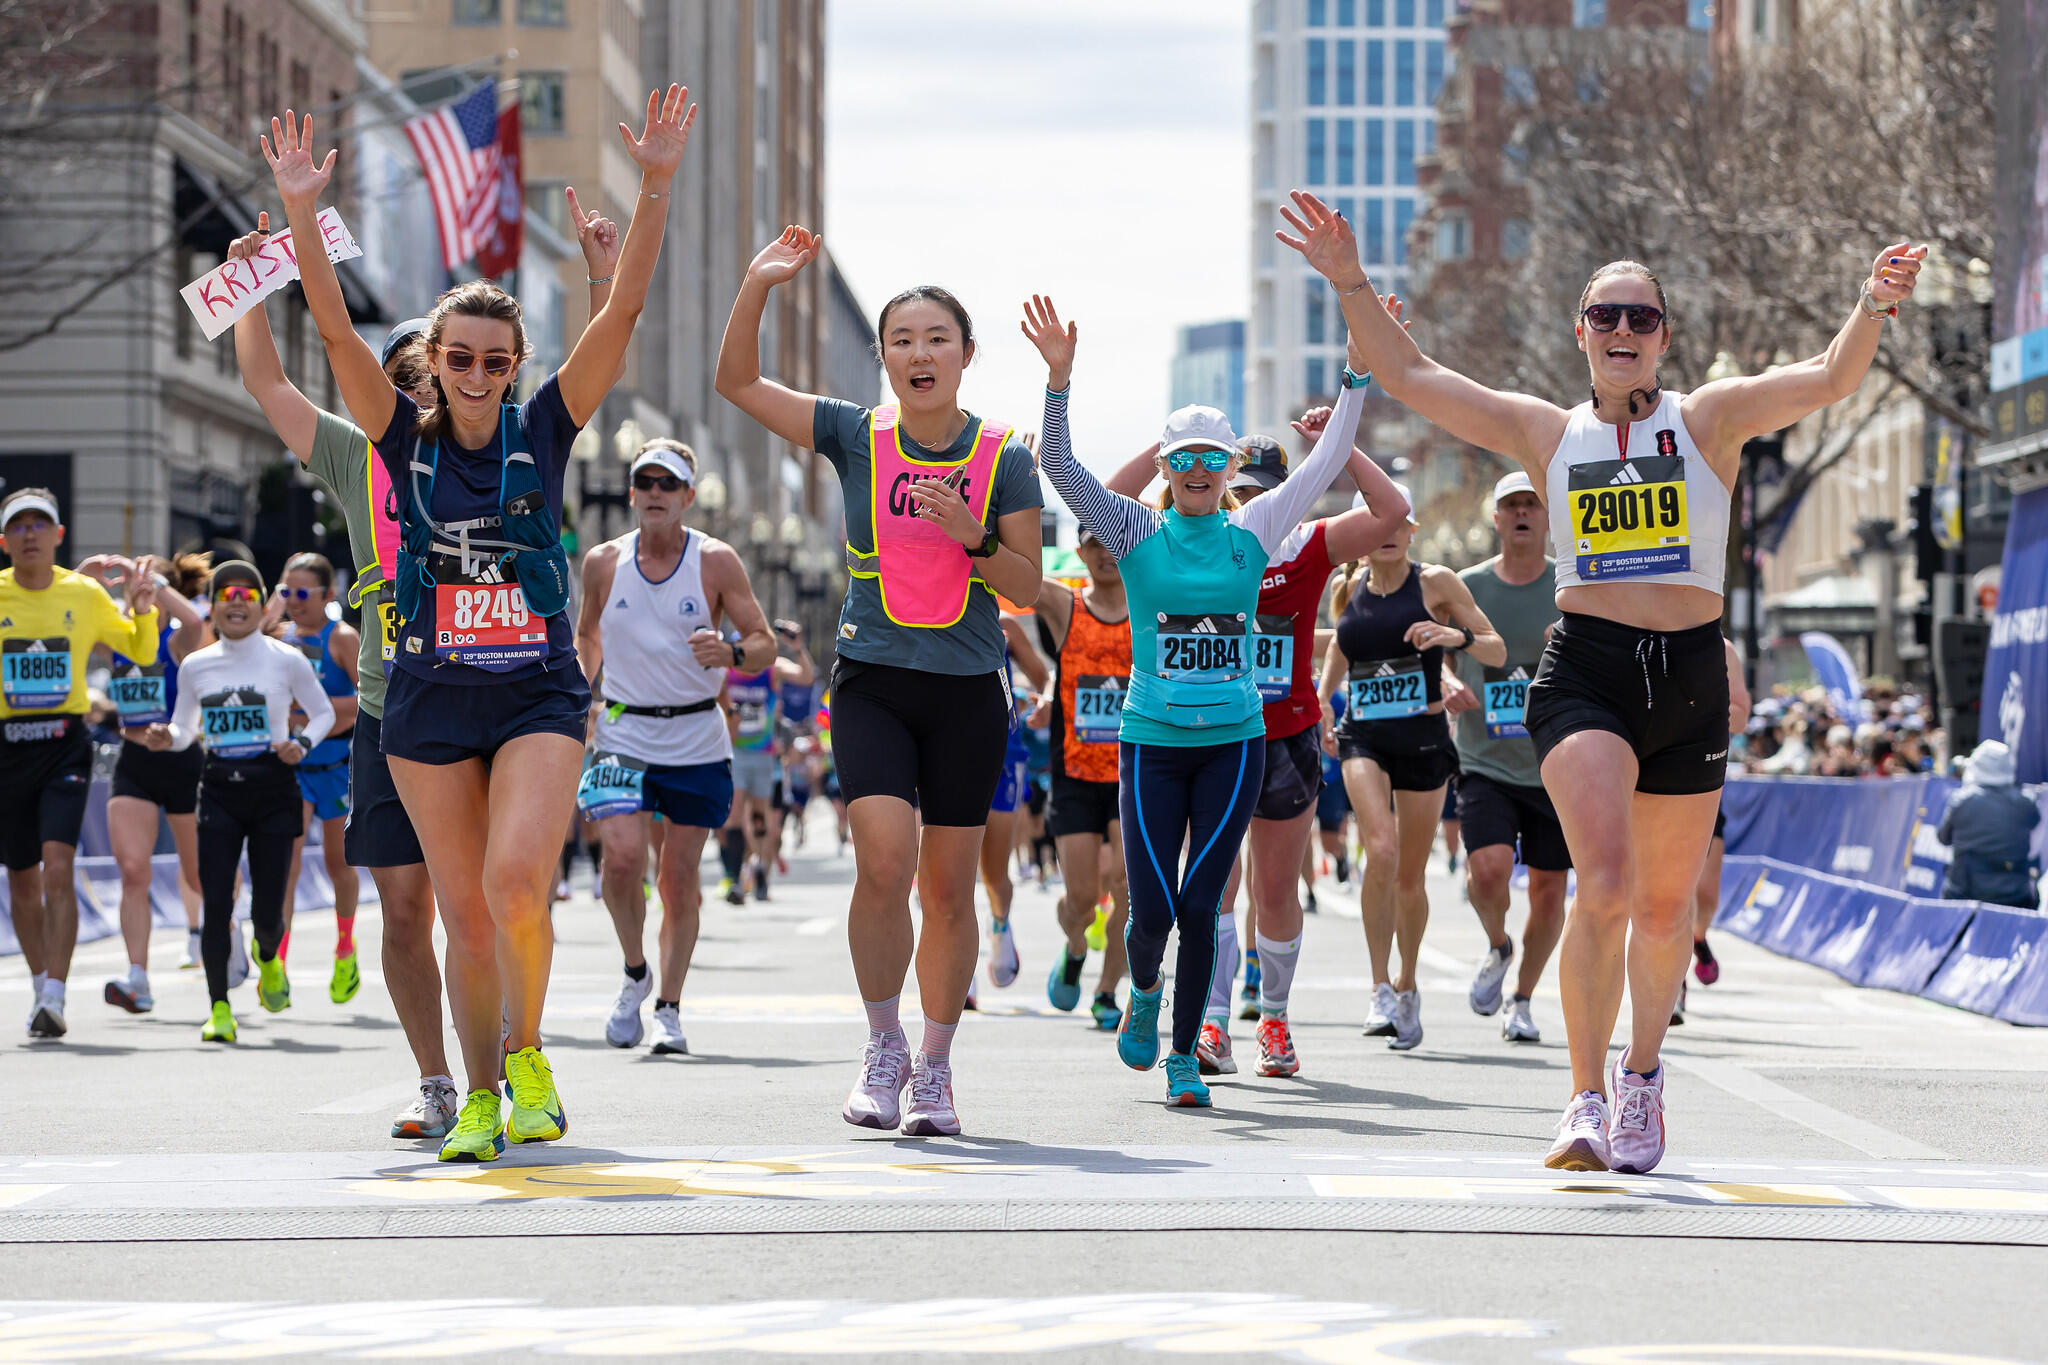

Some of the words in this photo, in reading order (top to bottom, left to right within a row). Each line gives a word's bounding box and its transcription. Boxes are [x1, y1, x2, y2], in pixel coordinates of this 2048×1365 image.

[1578, 486, 1680, 534] 29019
[1581, 541, 1589, 549] 4
[1616, 557, 1643, 566] BOSTON
[1644, 553, 1681, 563] MARATHON
[548, 560, 563, 594] NATHAN
[454, 588, 529, 629] 8249
[440, 632, 450, 644] 8
[385, 647, 391, 656] 7
[477, 652, 504, 660] BOSTON
[504, 650, 540, 659] MARATHON
[1164, 637, 1241, 670] 25084
[9, 656, 66, 680] 18805
[1357, 675, 1422, 706] 23822
[1491, 683, 1525, 709] 229
[207, 709, 266, 735] 23755
